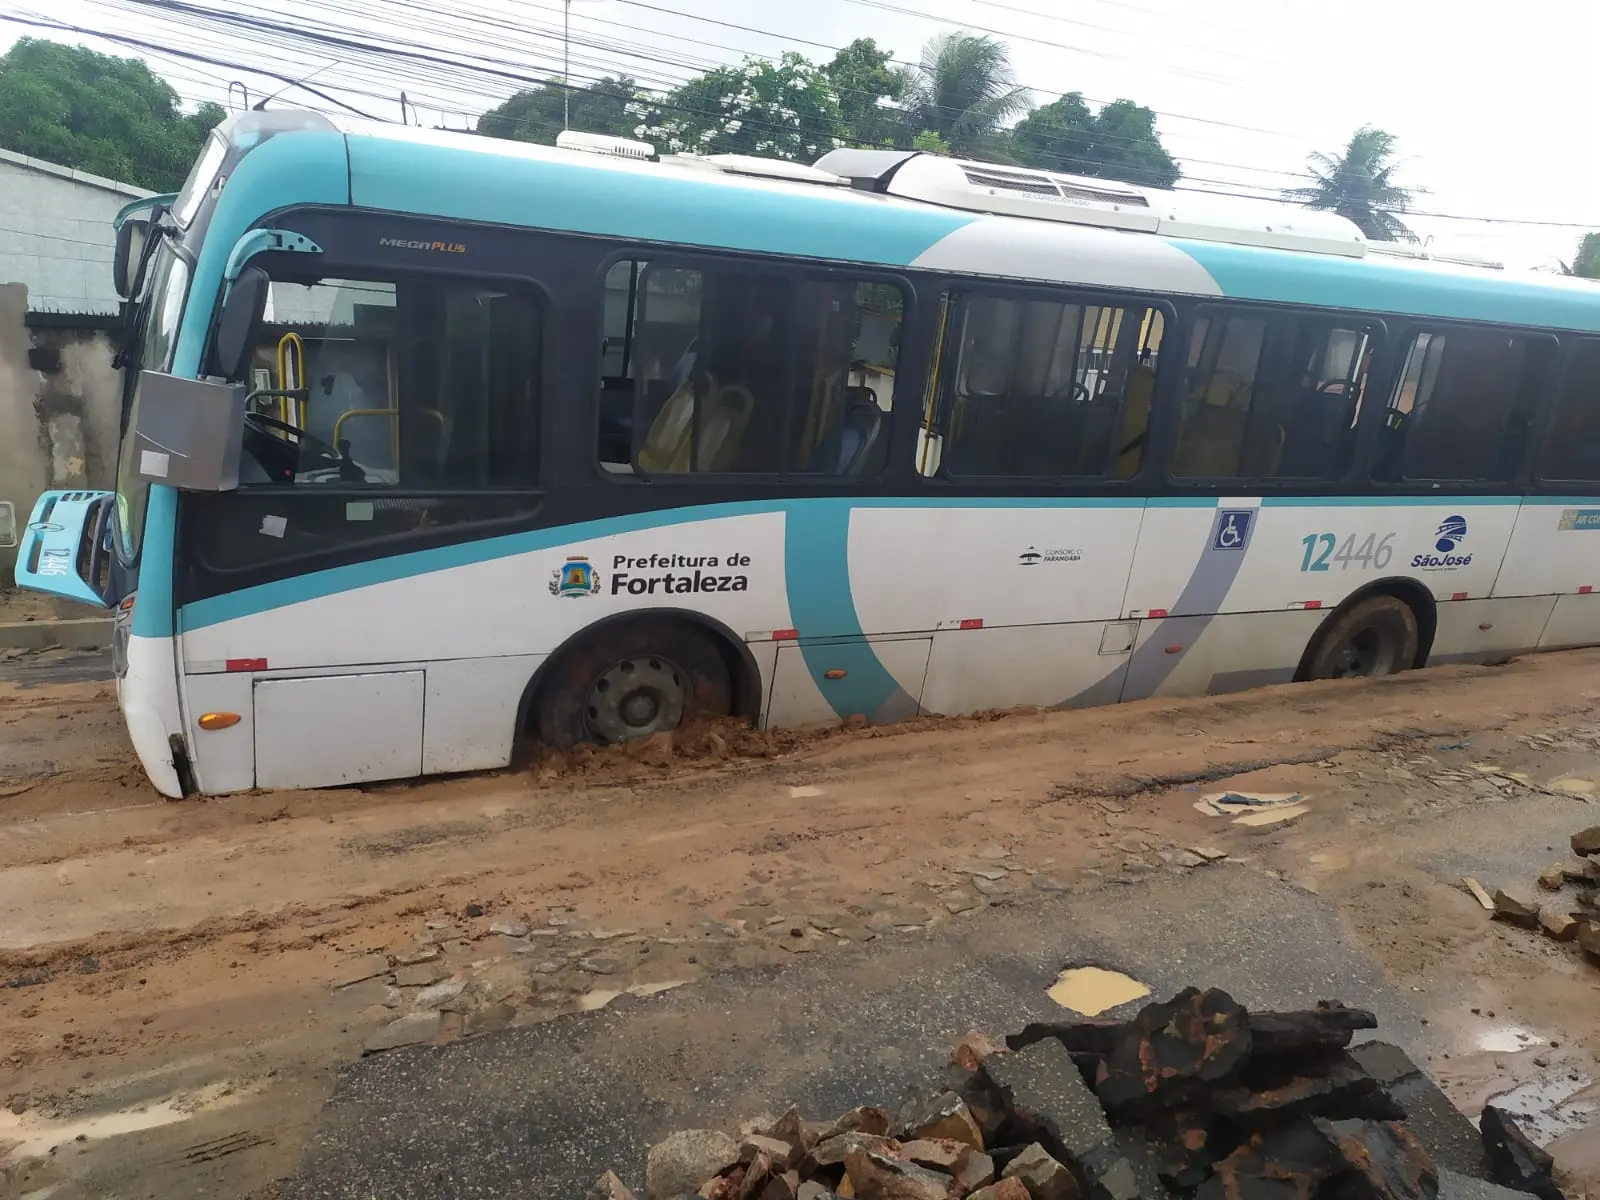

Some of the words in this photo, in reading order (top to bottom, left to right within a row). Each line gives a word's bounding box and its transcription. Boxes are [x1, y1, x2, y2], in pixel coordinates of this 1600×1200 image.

[40, 548, 71, 576] 12446
[613, 554, 718, 569] Prefeitura
[726, 553, 751, 567] de
[1300, 532, 1397, 572] 12446
[611, 570, 748, 595] Fortaleza
